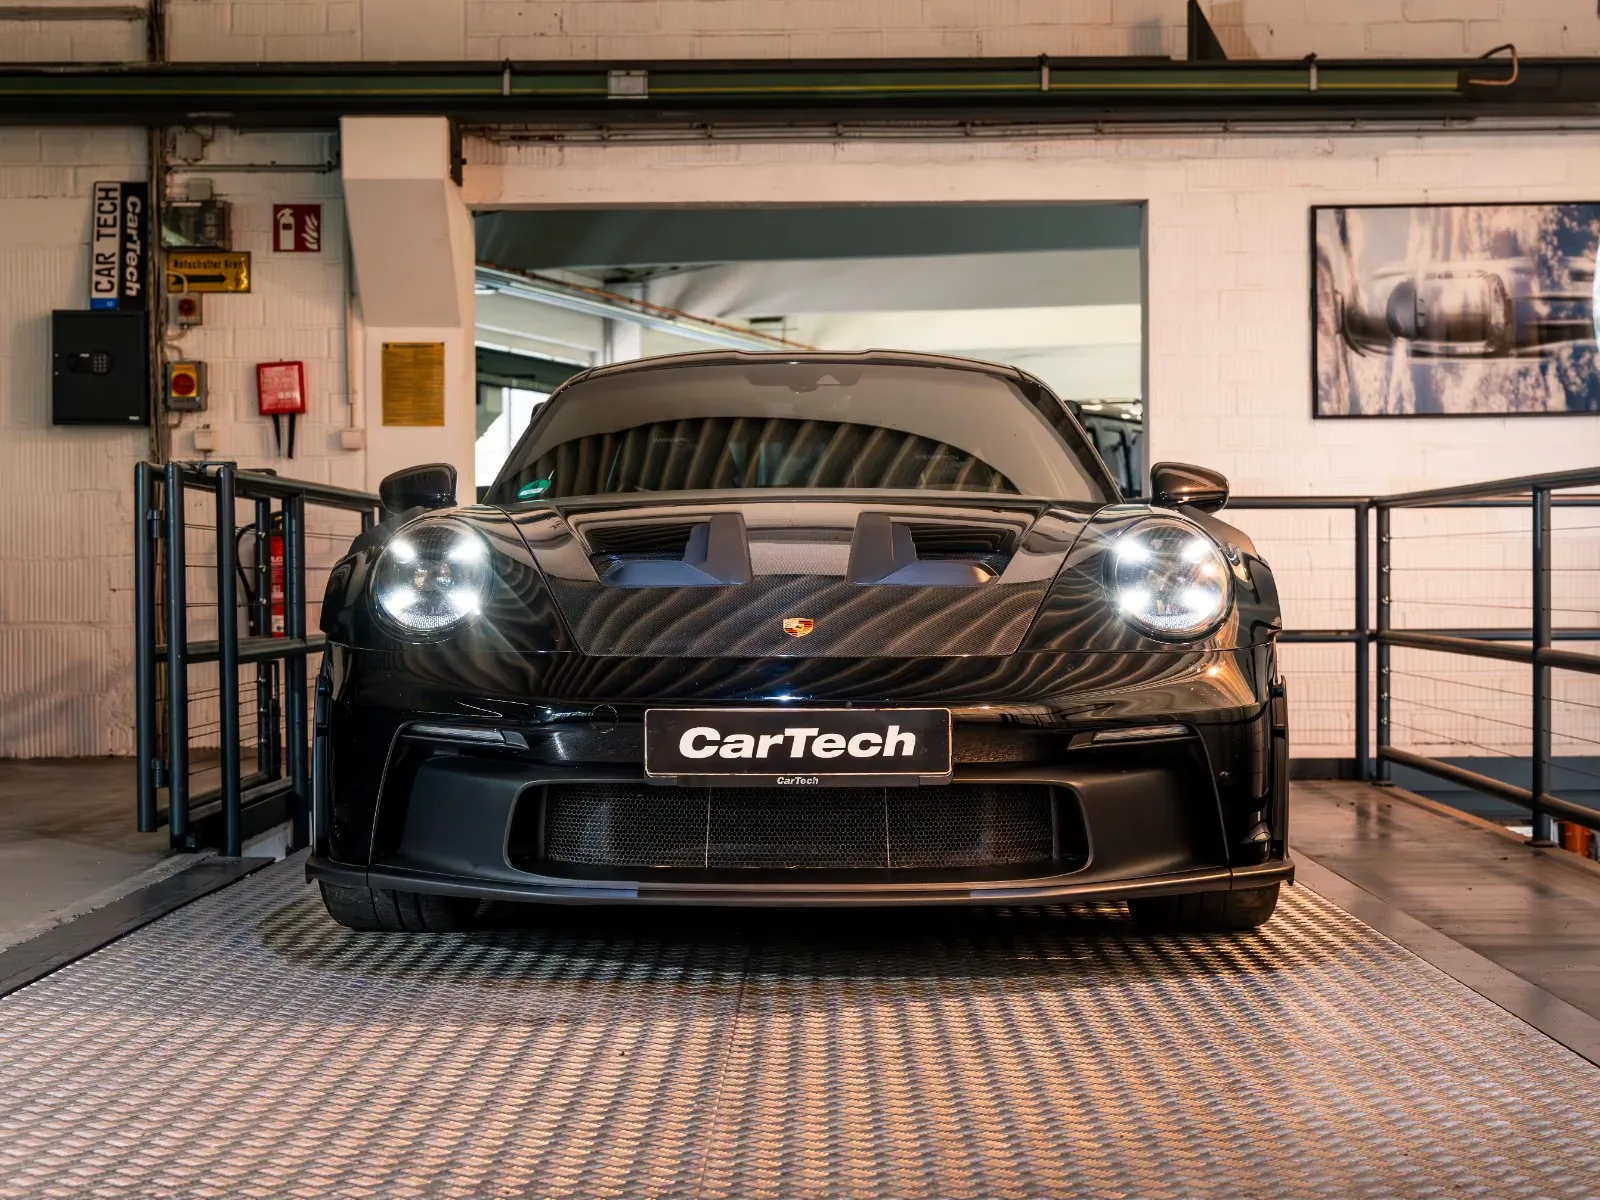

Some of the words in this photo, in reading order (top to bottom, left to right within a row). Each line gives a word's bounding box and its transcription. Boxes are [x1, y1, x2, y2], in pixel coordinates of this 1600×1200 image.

[96, 188, 118, 242] TECH
[125, 195, 142, 297] CarTech
[95, 252, 116, 293] CAR
[679, 725, 916, 759] CarTech
[776, 776, 819, 786] CarTech
